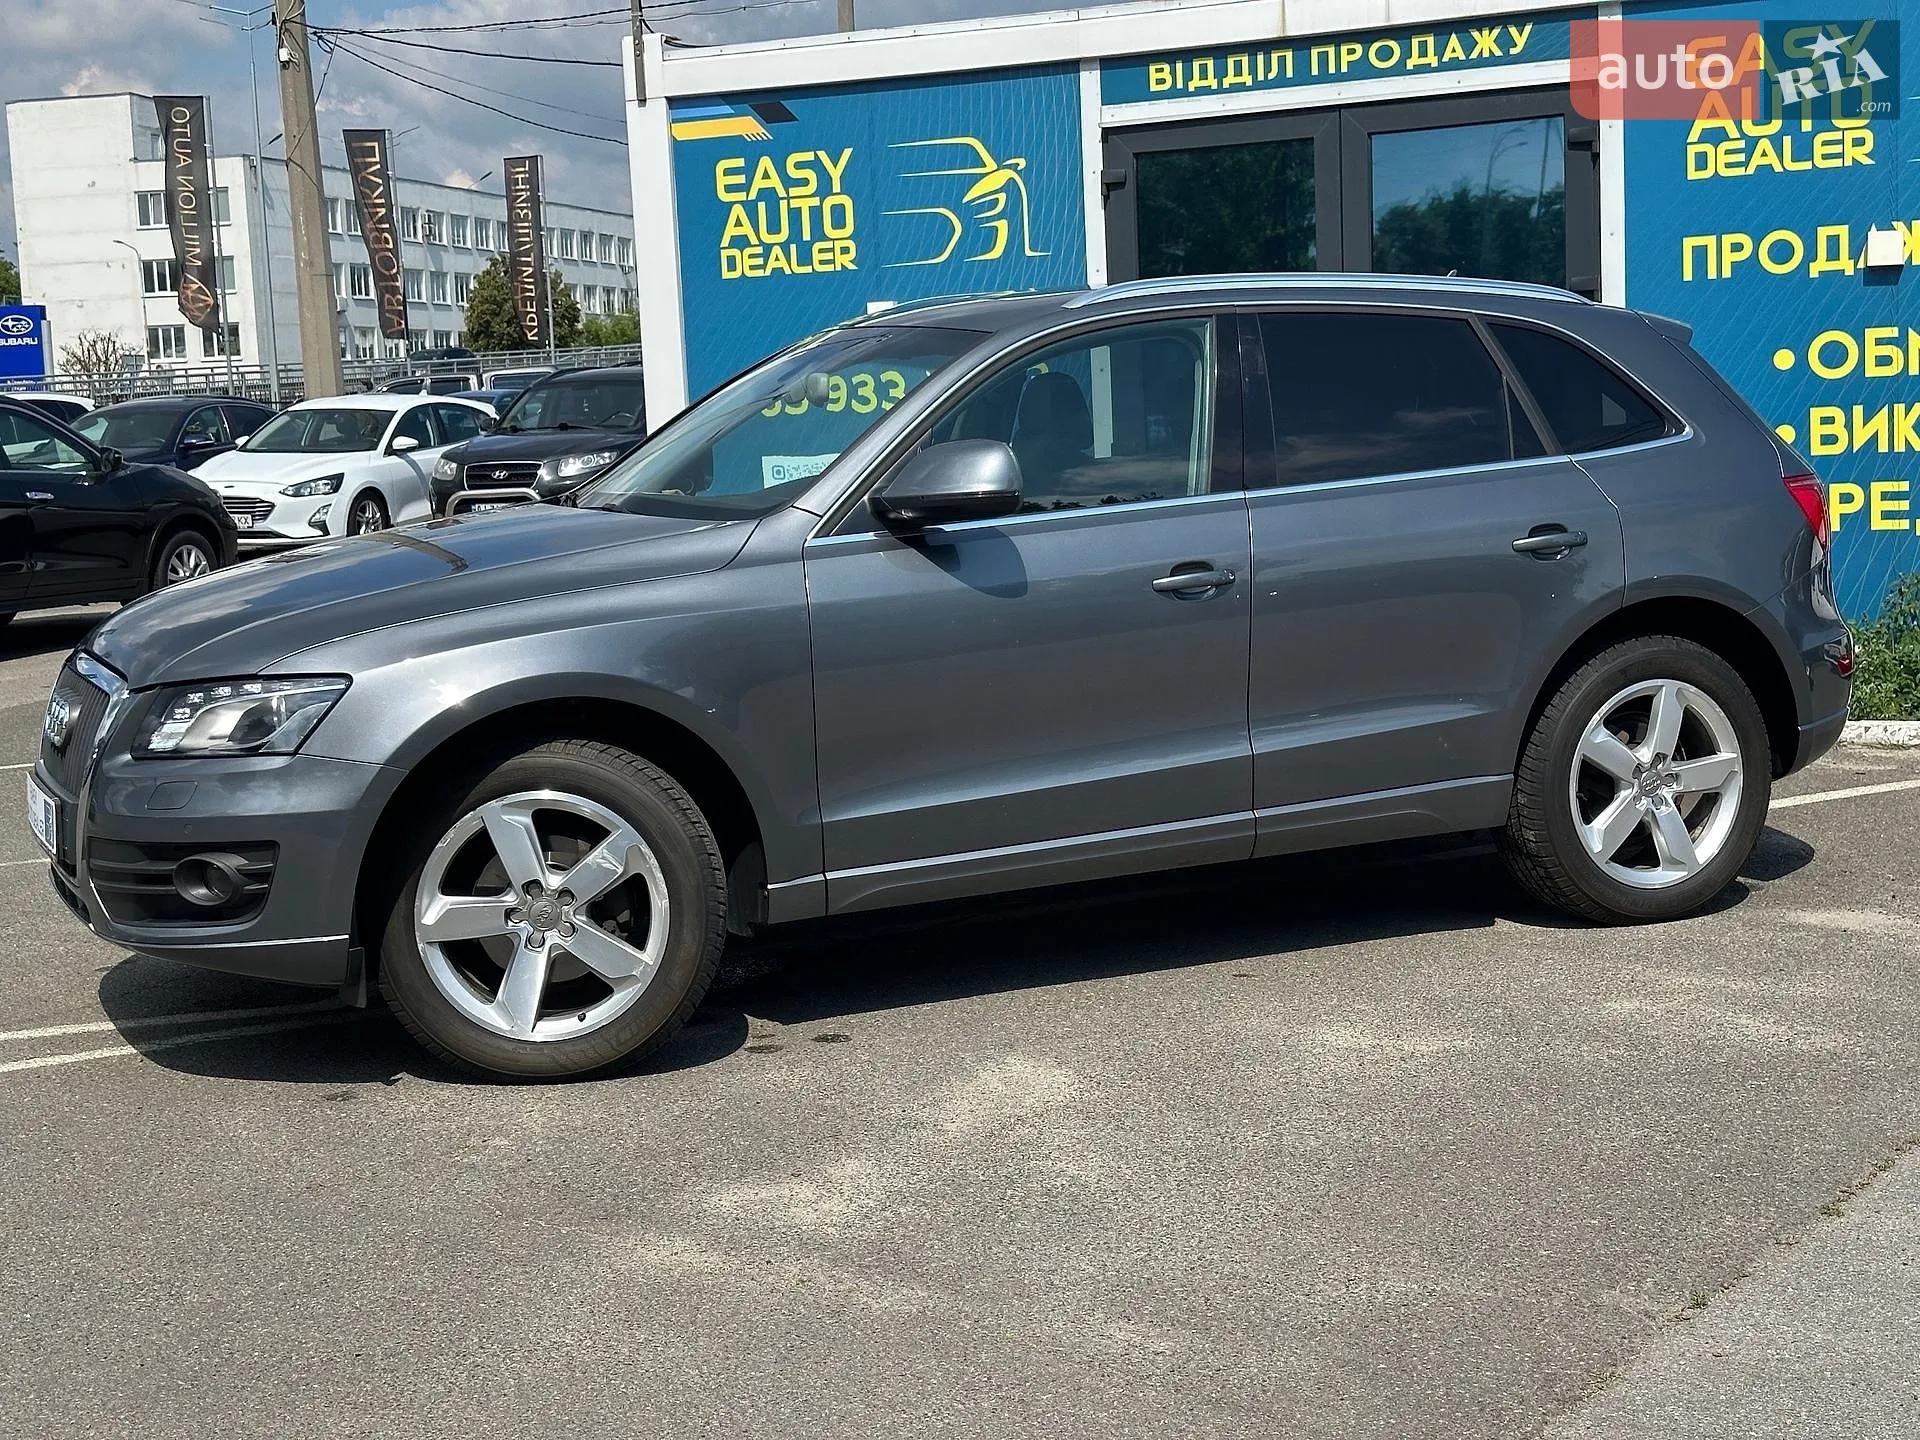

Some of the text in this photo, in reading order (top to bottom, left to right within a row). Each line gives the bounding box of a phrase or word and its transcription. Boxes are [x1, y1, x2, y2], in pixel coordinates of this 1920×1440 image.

[1148, 22, 1533, 92] ВІДДІЛ ПРОДАЖУ
[715, 148, 853, 202] EASY
[1686, 128, 1876, 180] DEALER
[720, 194, 855, 247] AUTO
[720, 239, 858, 280] DEALER
[1682, 220, 1920, 281] ПРОД
[1807, 326, 1920, 380] ОБ
